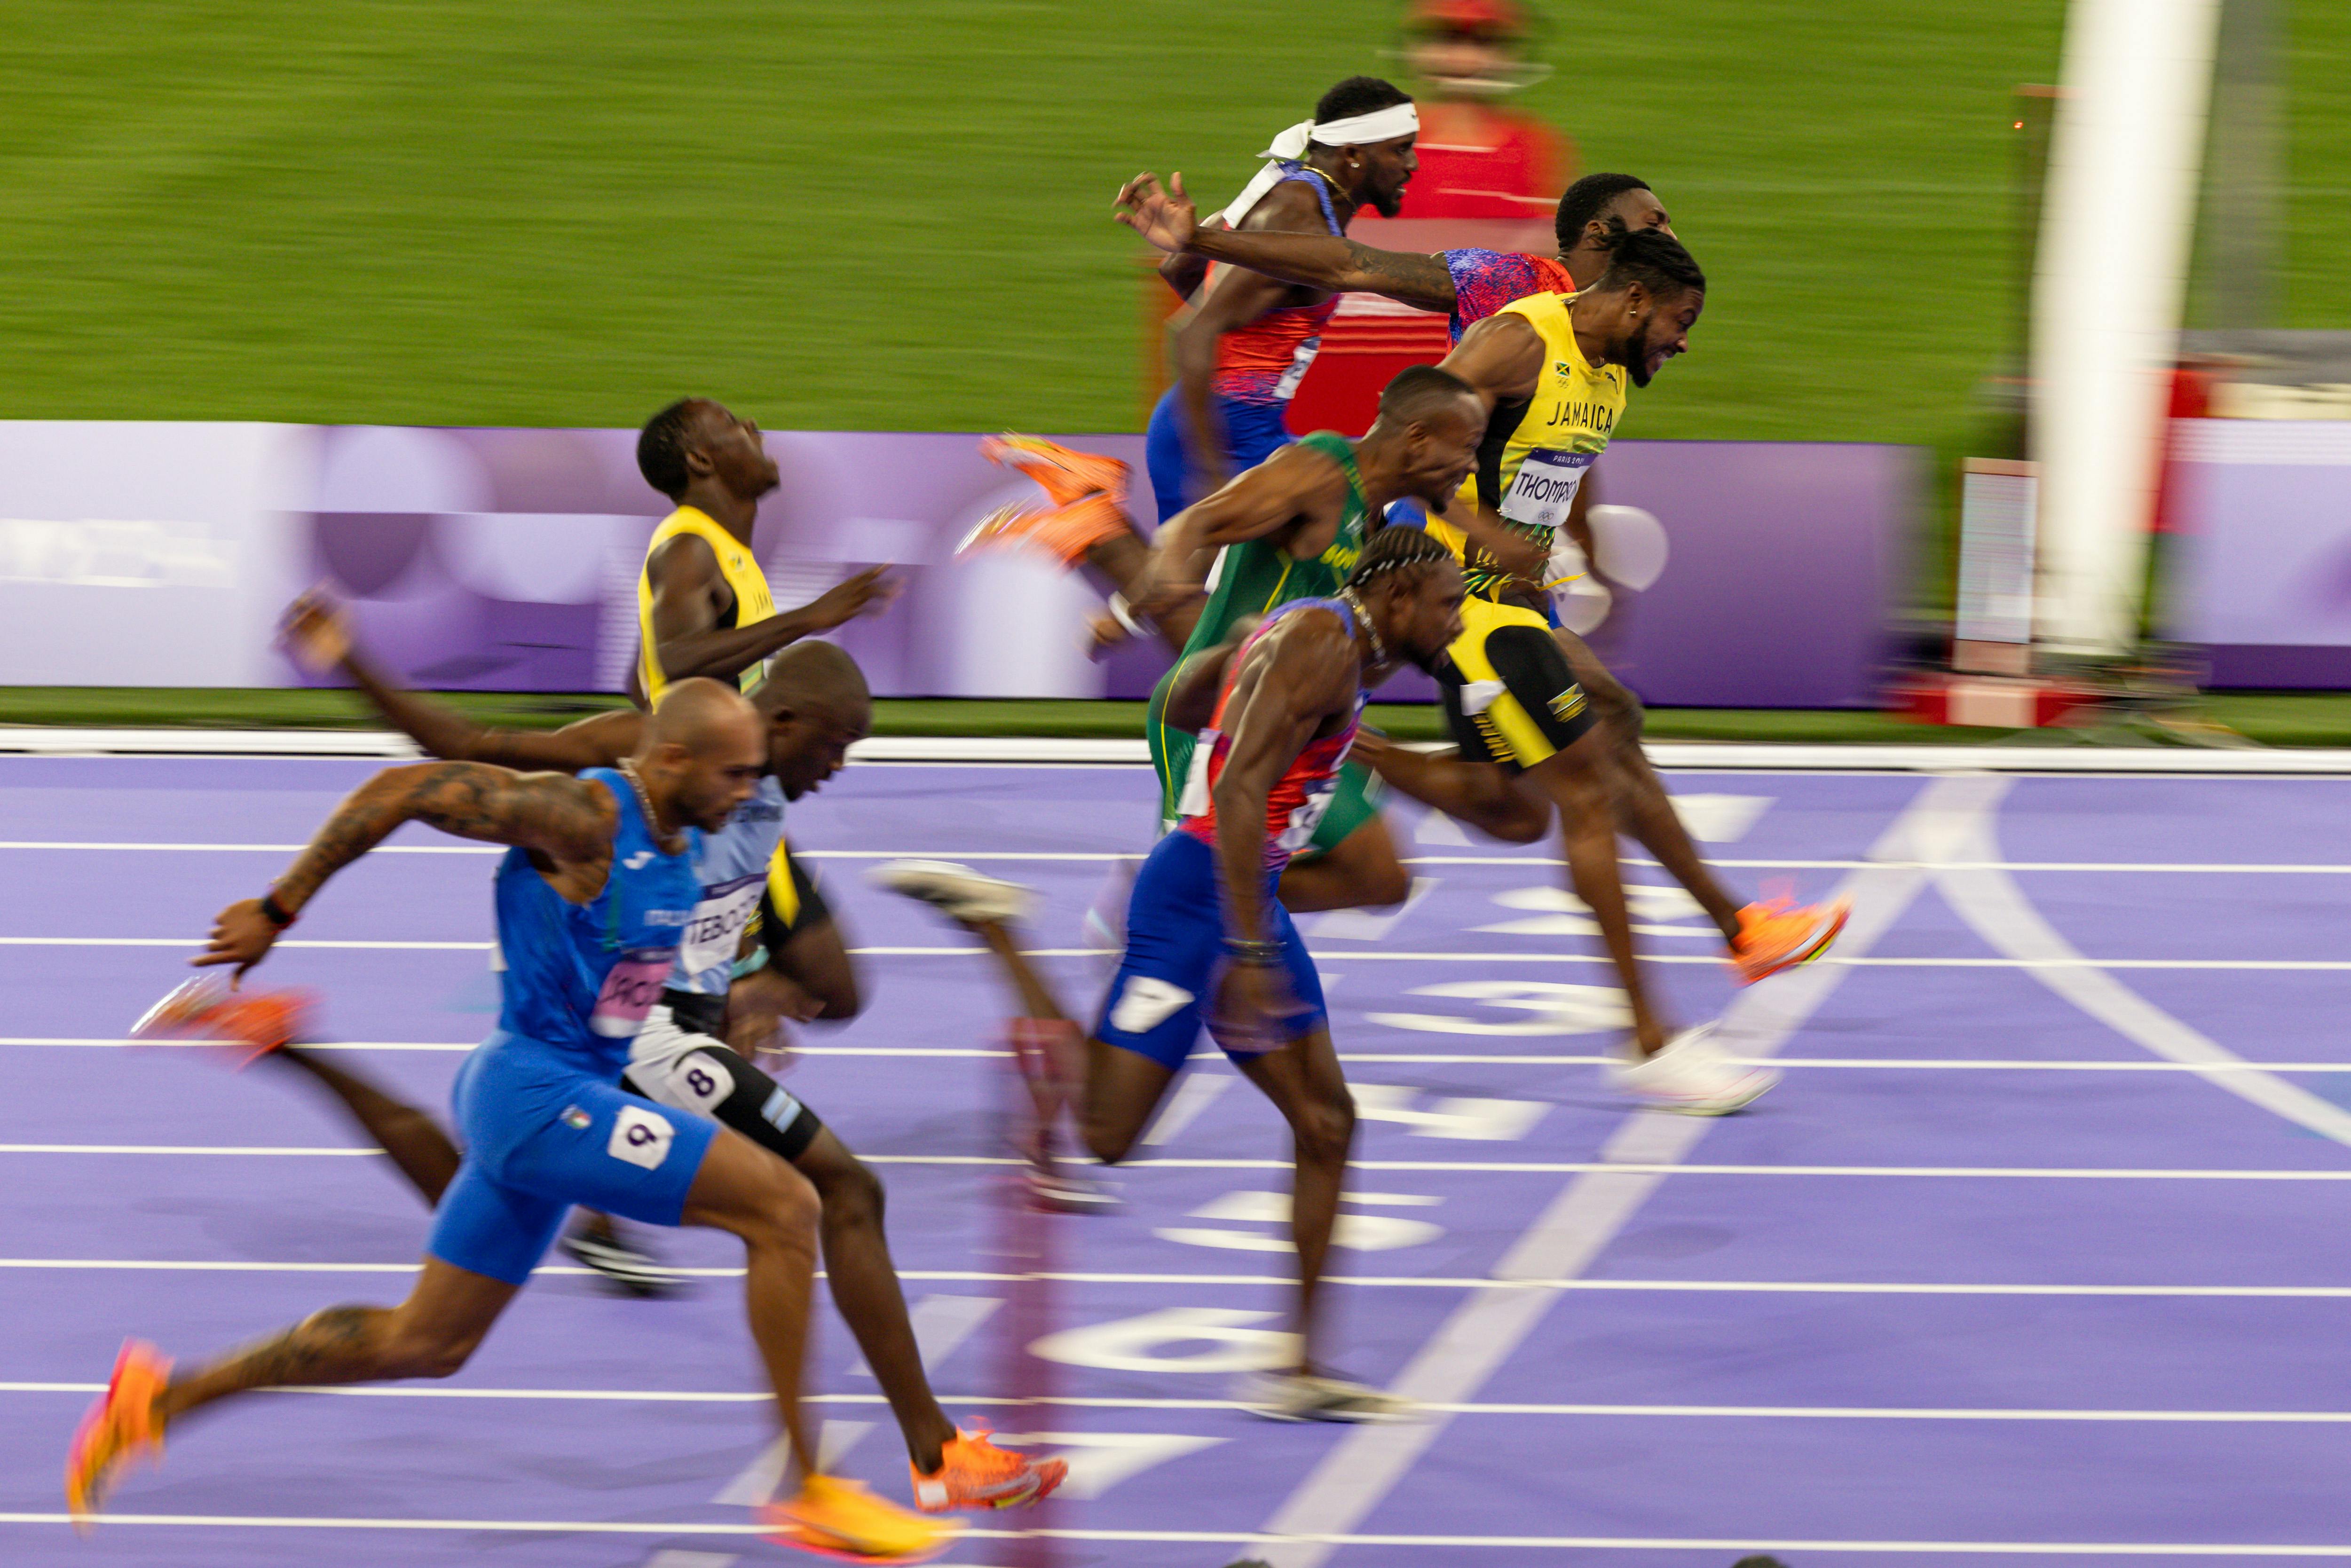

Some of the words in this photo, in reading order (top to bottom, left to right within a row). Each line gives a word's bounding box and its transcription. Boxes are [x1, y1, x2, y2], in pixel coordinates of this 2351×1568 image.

[1547, 401, 1612, 434] JAMAICA
[1553, 455, 1571, 464] PARIS
[686, 1068, 715, 1097] 8
[627, 1123, 657, 1146] 9
[1151, 1190, 1447, 1252] 5
